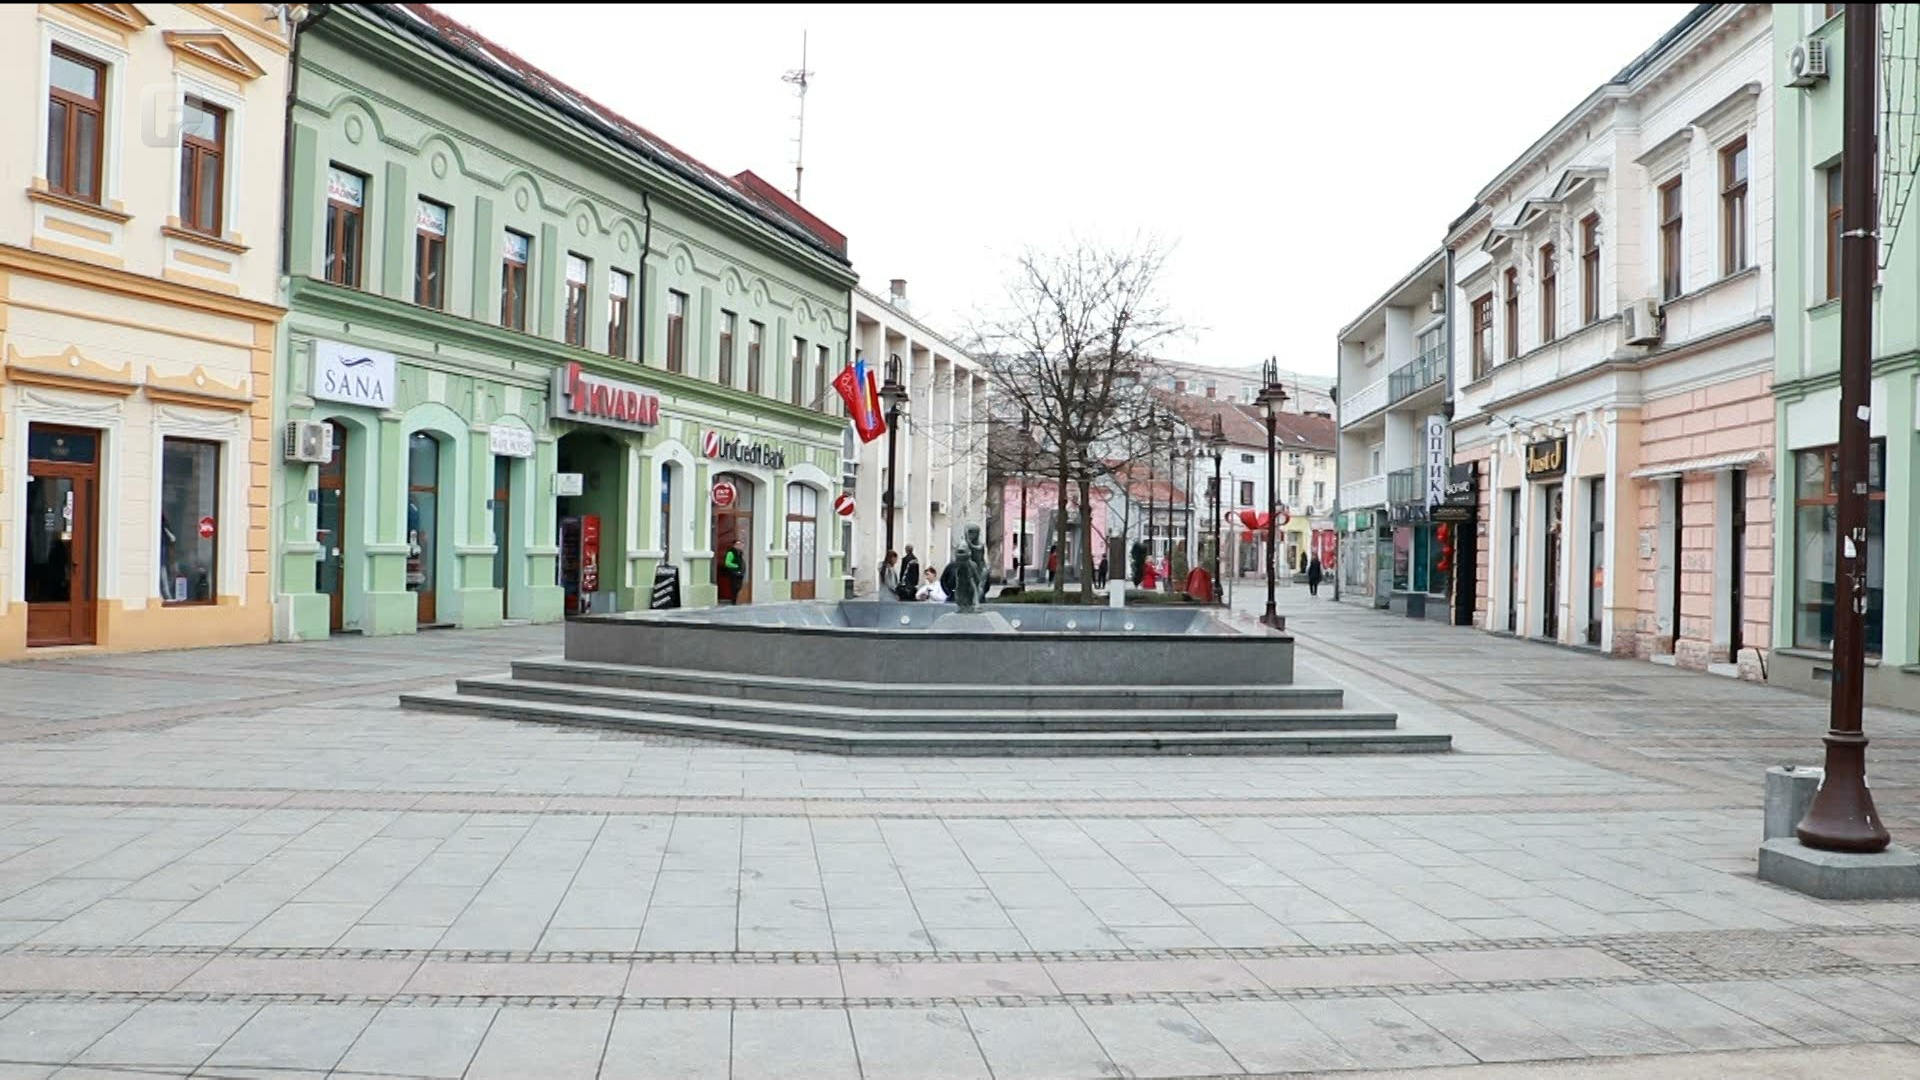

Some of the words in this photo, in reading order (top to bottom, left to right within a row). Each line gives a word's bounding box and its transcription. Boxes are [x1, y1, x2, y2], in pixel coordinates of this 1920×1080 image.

[325, 369, 384, 401] SANA
[591, 384, 659, 426] KVADAR
[719, 435, 762, 464] UniCredit
[764, 443, 785, 469] Bank
[1430, 422, 1443, 508] ОПТИКА
